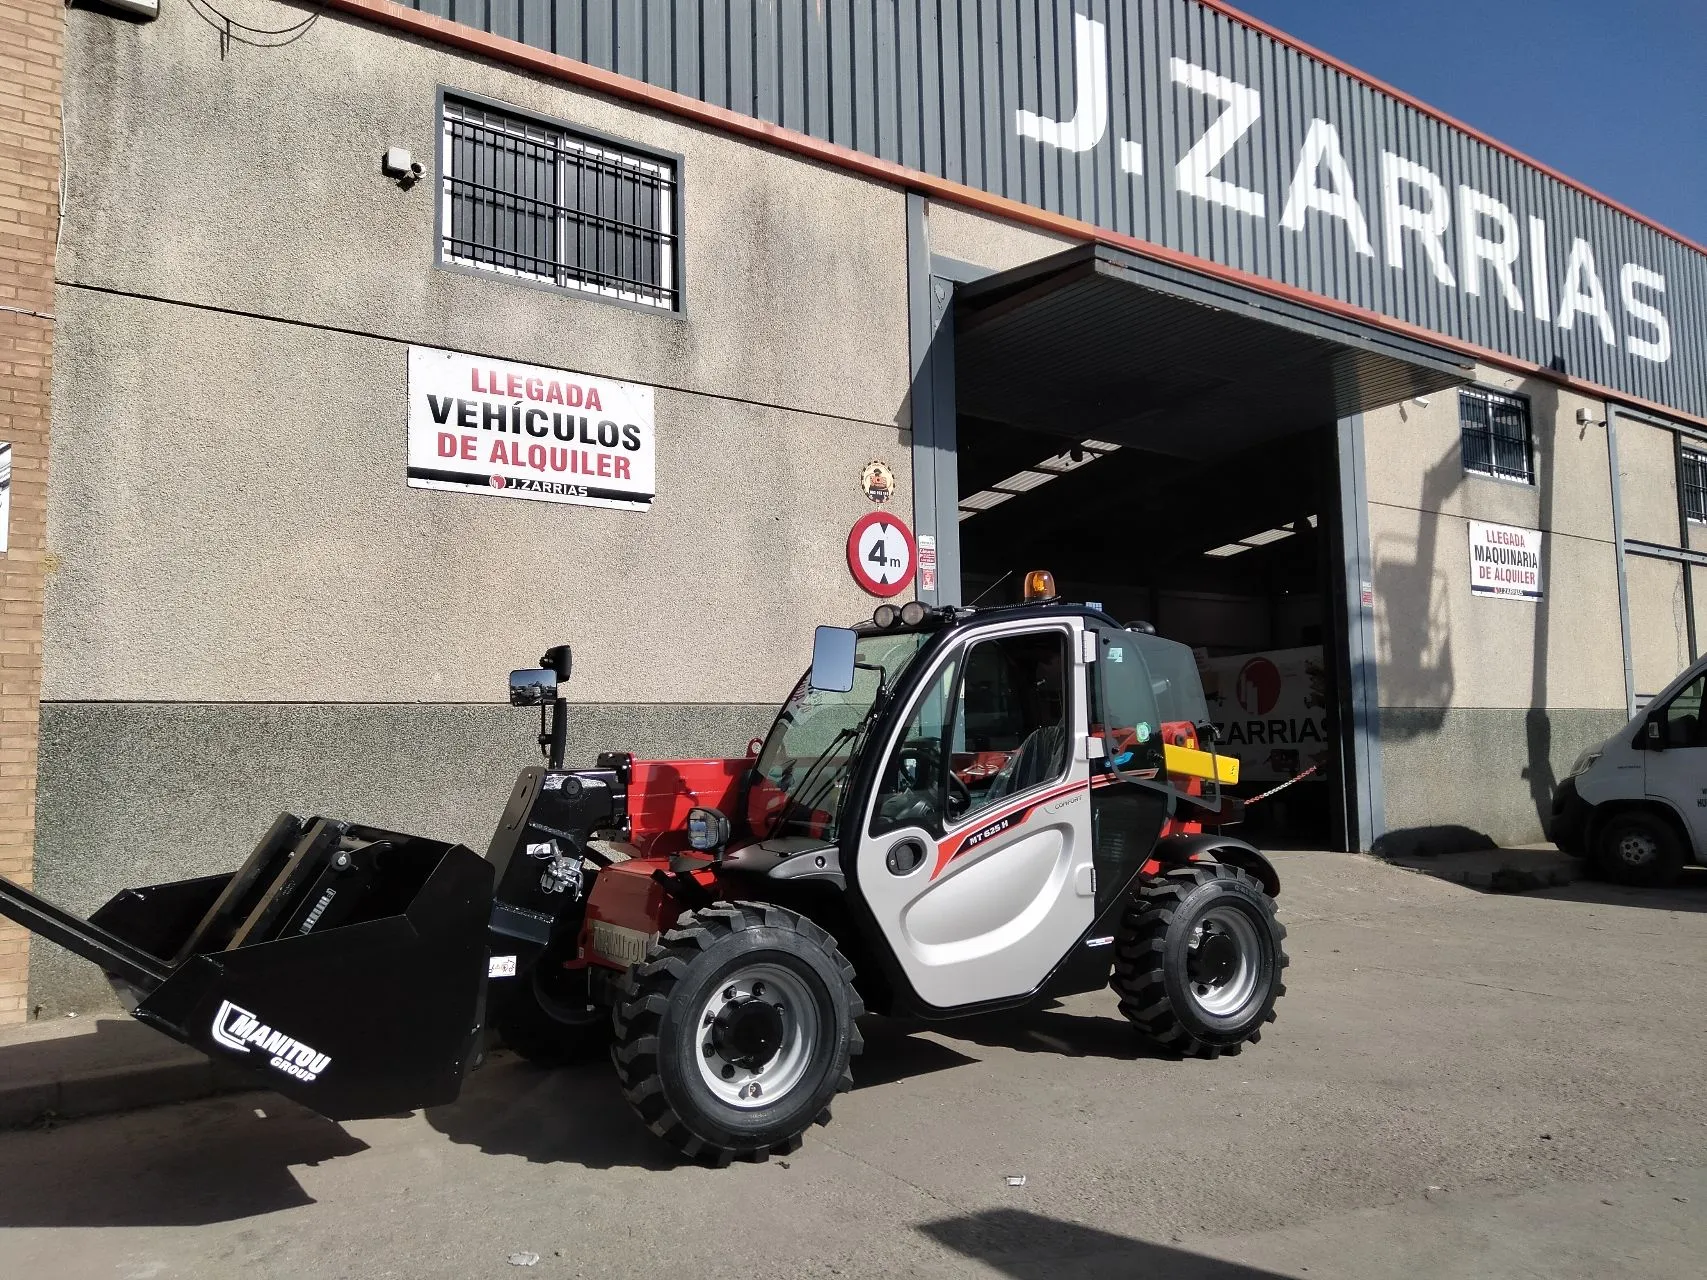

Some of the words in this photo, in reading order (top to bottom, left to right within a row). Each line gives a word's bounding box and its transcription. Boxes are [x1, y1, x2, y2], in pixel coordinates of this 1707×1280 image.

[471, 367, 603, 412] LLEGADA
[426, 393, 641, 451] VEHÍCULOS
[437, 431, 478, 461] DE
[489, 439, 631, 480] ALQUILER
[1486, 530, 1525, 547] LLEGADA
[1474, 545, 1537, 568] MAQUINARIA
[1479, 565, 1492, 579] DE
[1494, 567, 1536, 585] ALQUILER
[969, 833, 982, 846] MT
[983, 824, 1001, 839] 625
[1001, 820, 1009, 829] H
[228, 1013, 332, 1074] MANITOU
[269, 1056, 317, 1081] GROUP
